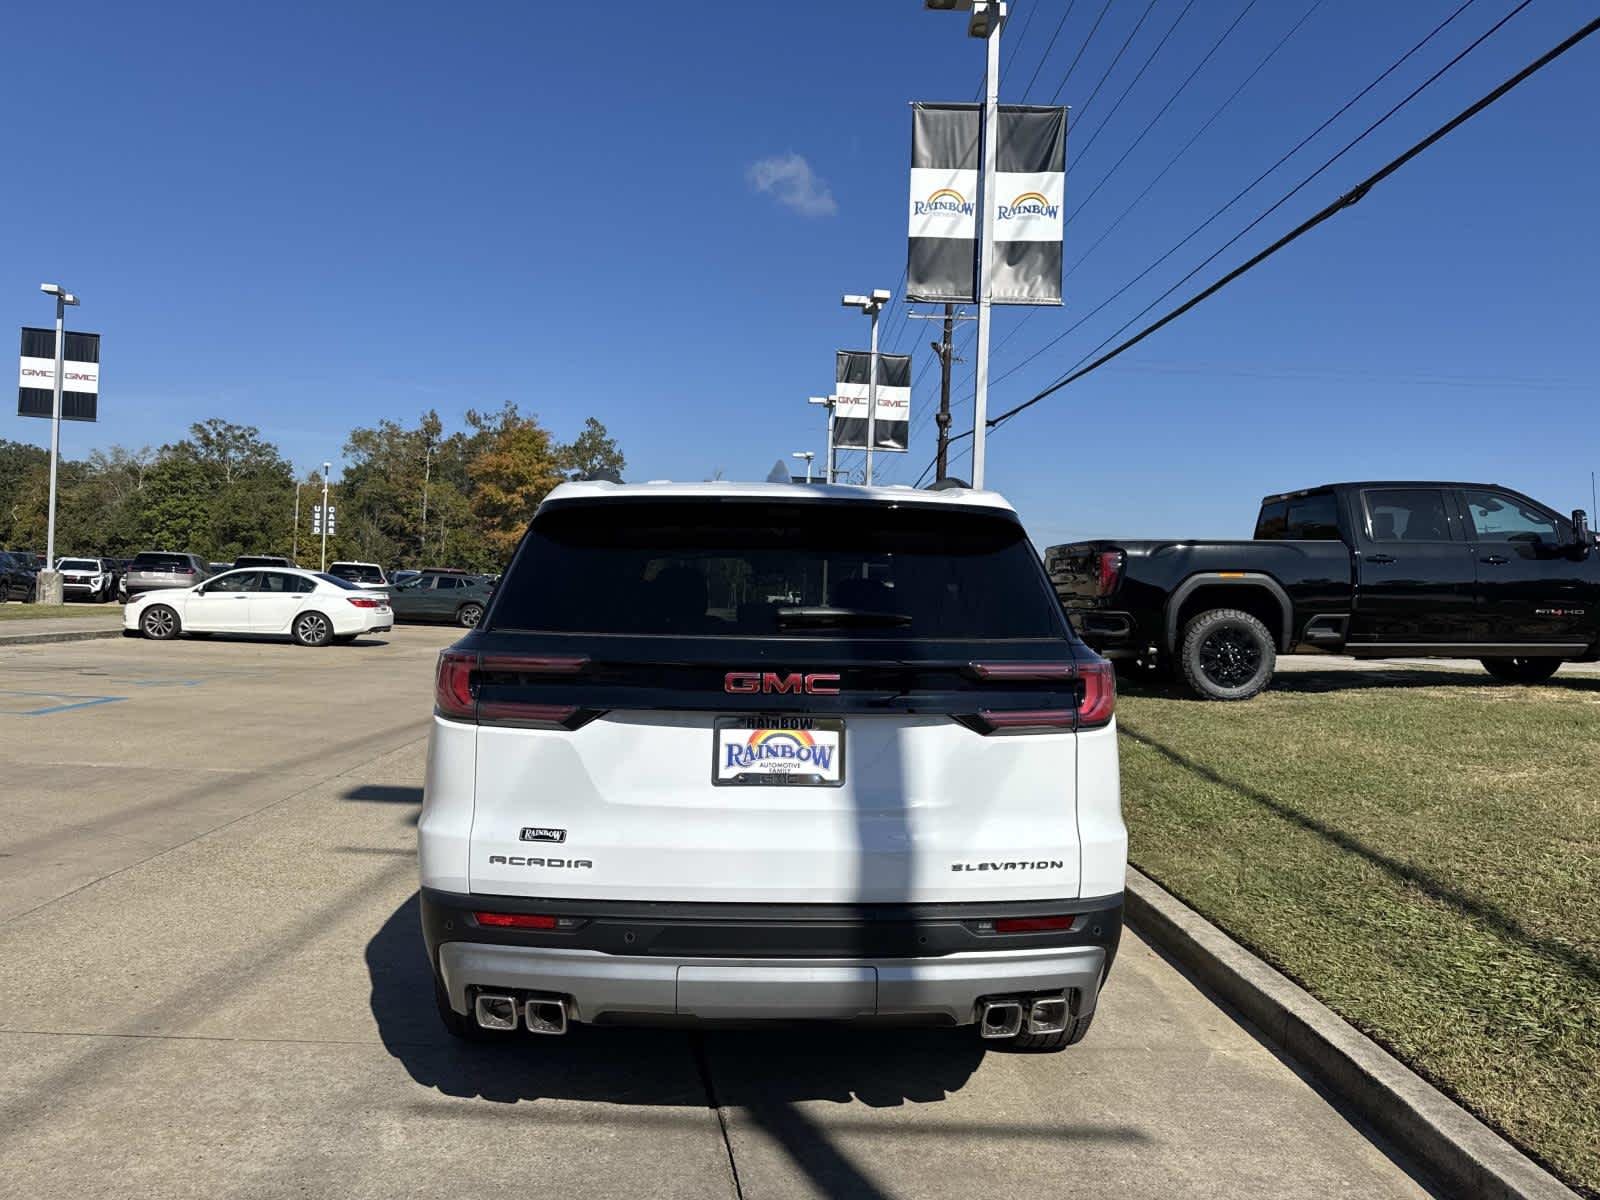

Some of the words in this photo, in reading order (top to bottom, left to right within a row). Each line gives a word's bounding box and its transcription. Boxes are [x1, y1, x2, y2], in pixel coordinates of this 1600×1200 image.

[914, 201, 976, 217] RAINBOW
[997, 205, 1060, 220] RAINBOW
[22, 368, 55, 378] GMC
[64, 372, 97, 382] GMC
[838, 396, 868, 405] GMC
[877, 398, 909, 408] GMC
[724, 672, 841, 695] GMC
[746, 717, 814, 730] RAINBOW
[724, 743, 836, 770] RAINBOW
[525, 829, 561, 841] RAINBOW
[489, 855, 593, 869] ACADIA
[951, 860, 1064, 872] ELEVATION
